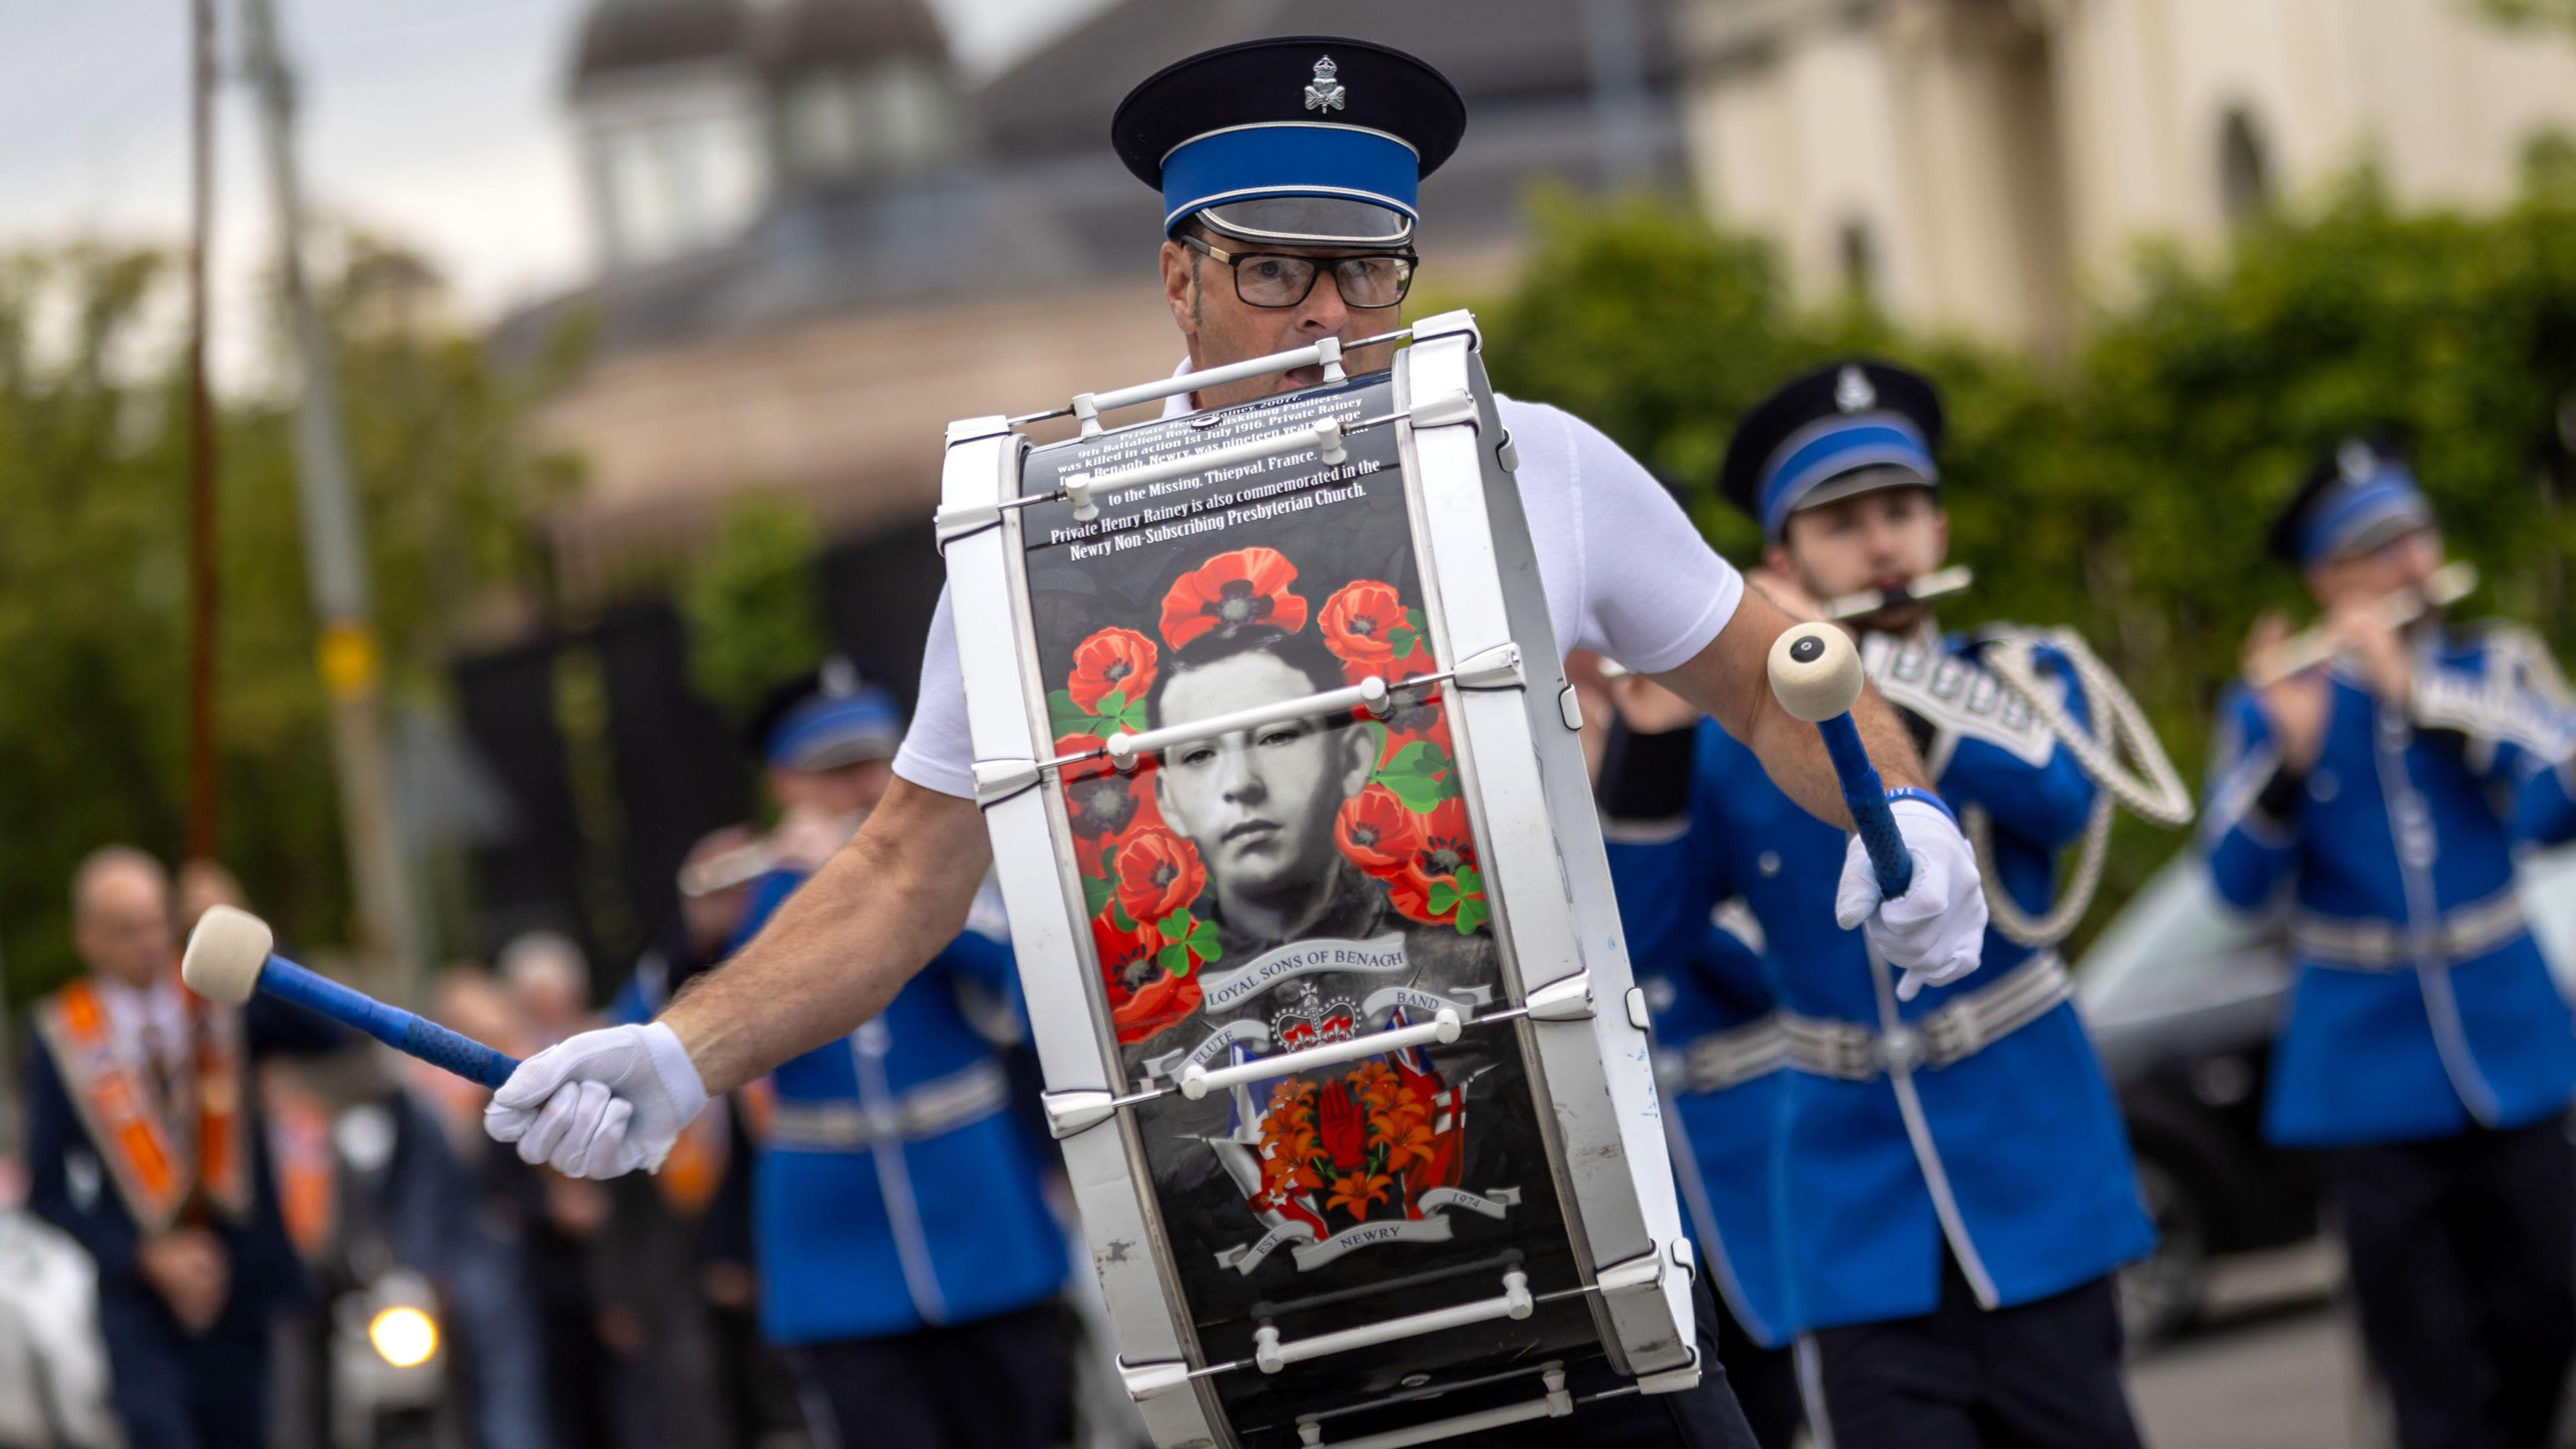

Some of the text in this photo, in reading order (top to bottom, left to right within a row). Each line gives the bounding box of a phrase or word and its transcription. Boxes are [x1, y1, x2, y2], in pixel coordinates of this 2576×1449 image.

[1057, 462, 1081, 474] was
[1085, 450, 1121, 468] killed
[1125, 448, 1138, 459] in
[1141, 439, 1181, 455] action
[1185, 431, 1201, 445] 1st
[1204, 427, 1231, 441] July
[1235, 421, 1265, 433] 1916.
[1269, 410, 1314, 426] Private
[1318, 398, 1362, 415] Rainey
[1078, 447, 1099, 459] 9th
[1103, 433, 1163, 453] Battalion
[1166, 427, 1201, 438] Roya
[1283, 394, 1342, 413] Fusiliers.
[1120, 425, 1166, 441] Private
[1194, 441, 1222, 455] was
[1222, 428, 1280, 449] nineteen
[1336, 411, 1361, 423] age
[1108, 451, 1318, 506] to the Missing, Thiepval, France.
[1051, 458, 1381, 545] Private Henry Rainey is also commemorated in the
[1070, 482, 1367, 561] Newry Non-Subscribing Presbyterian Church.
[1884, 786, 1915, 798] IVE
[1208, 950, 1404, 1006] LOYAL SONS OF BENAGH
[1396, 991, 1440, 1010] BAND
[1193, 1030, 1235, 1065] FLUTE
[1452, 1193, 1481, 1208] 1974
[1256, 1233, 1283, 1255] EST.
[1340, 1226, 1401, 1248] NEWRY
